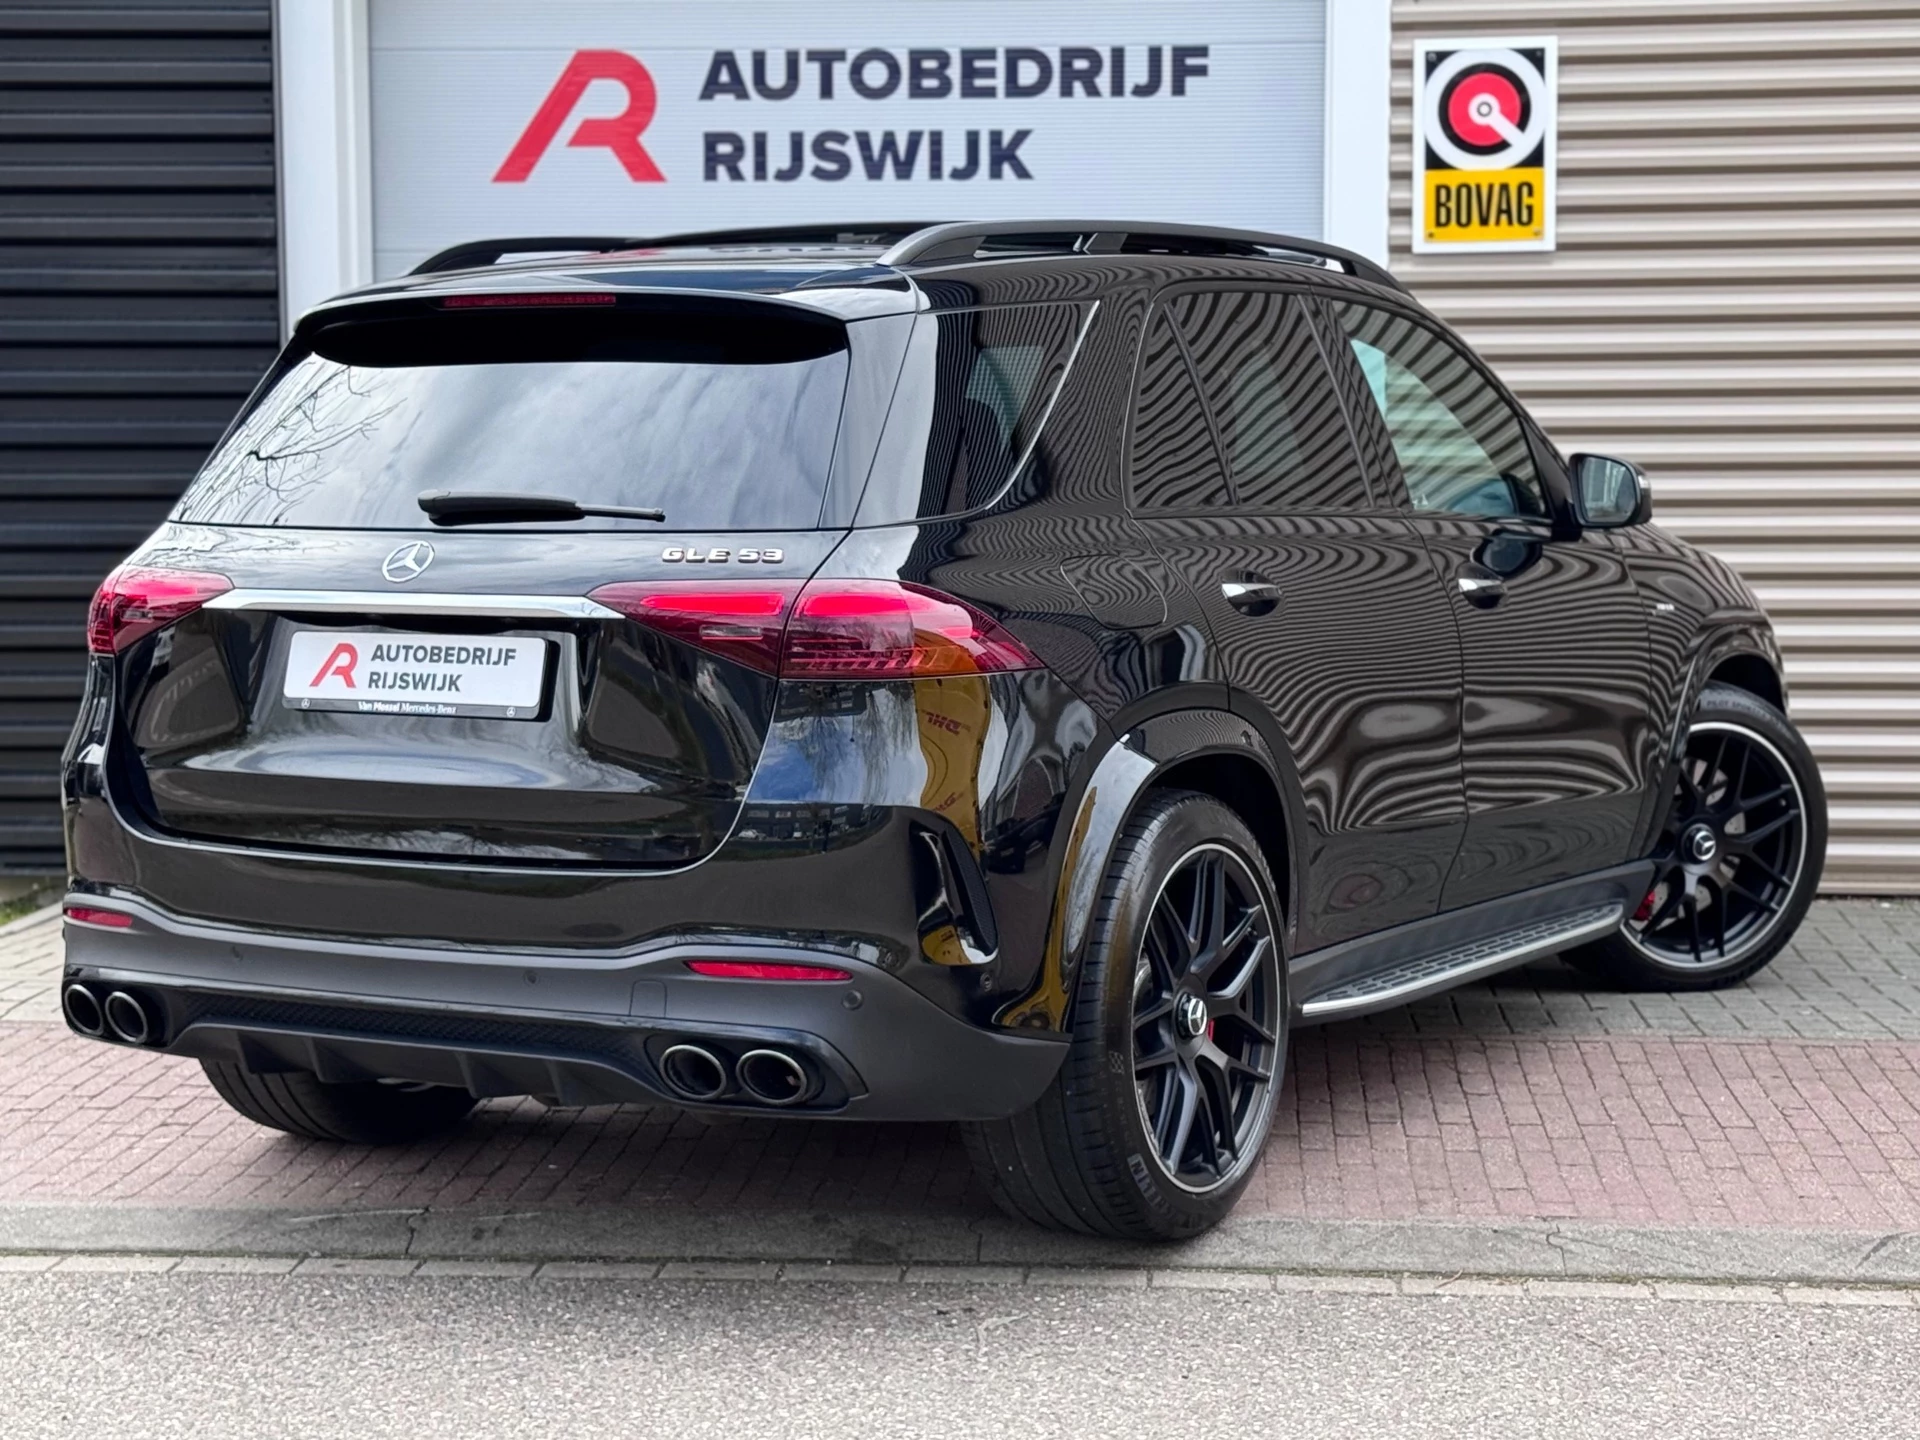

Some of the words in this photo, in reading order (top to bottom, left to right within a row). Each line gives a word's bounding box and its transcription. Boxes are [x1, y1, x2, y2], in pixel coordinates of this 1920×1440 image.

[699, 45, 1210, 101] AUTOBEDRIJF
[703, 129, 1034, 182] RIJSWIJK
[1434, 181, 1535, 228] BOVAG
[661, 547, 731, 563] GLE
[737, 548, 784, 564] 53
[370, 644, 517, 667] AUTOBEDRIJF
[367, 671, 462, 692] RIJSWIJK
[401, 702, 457, 714] Mercedes-Benz
